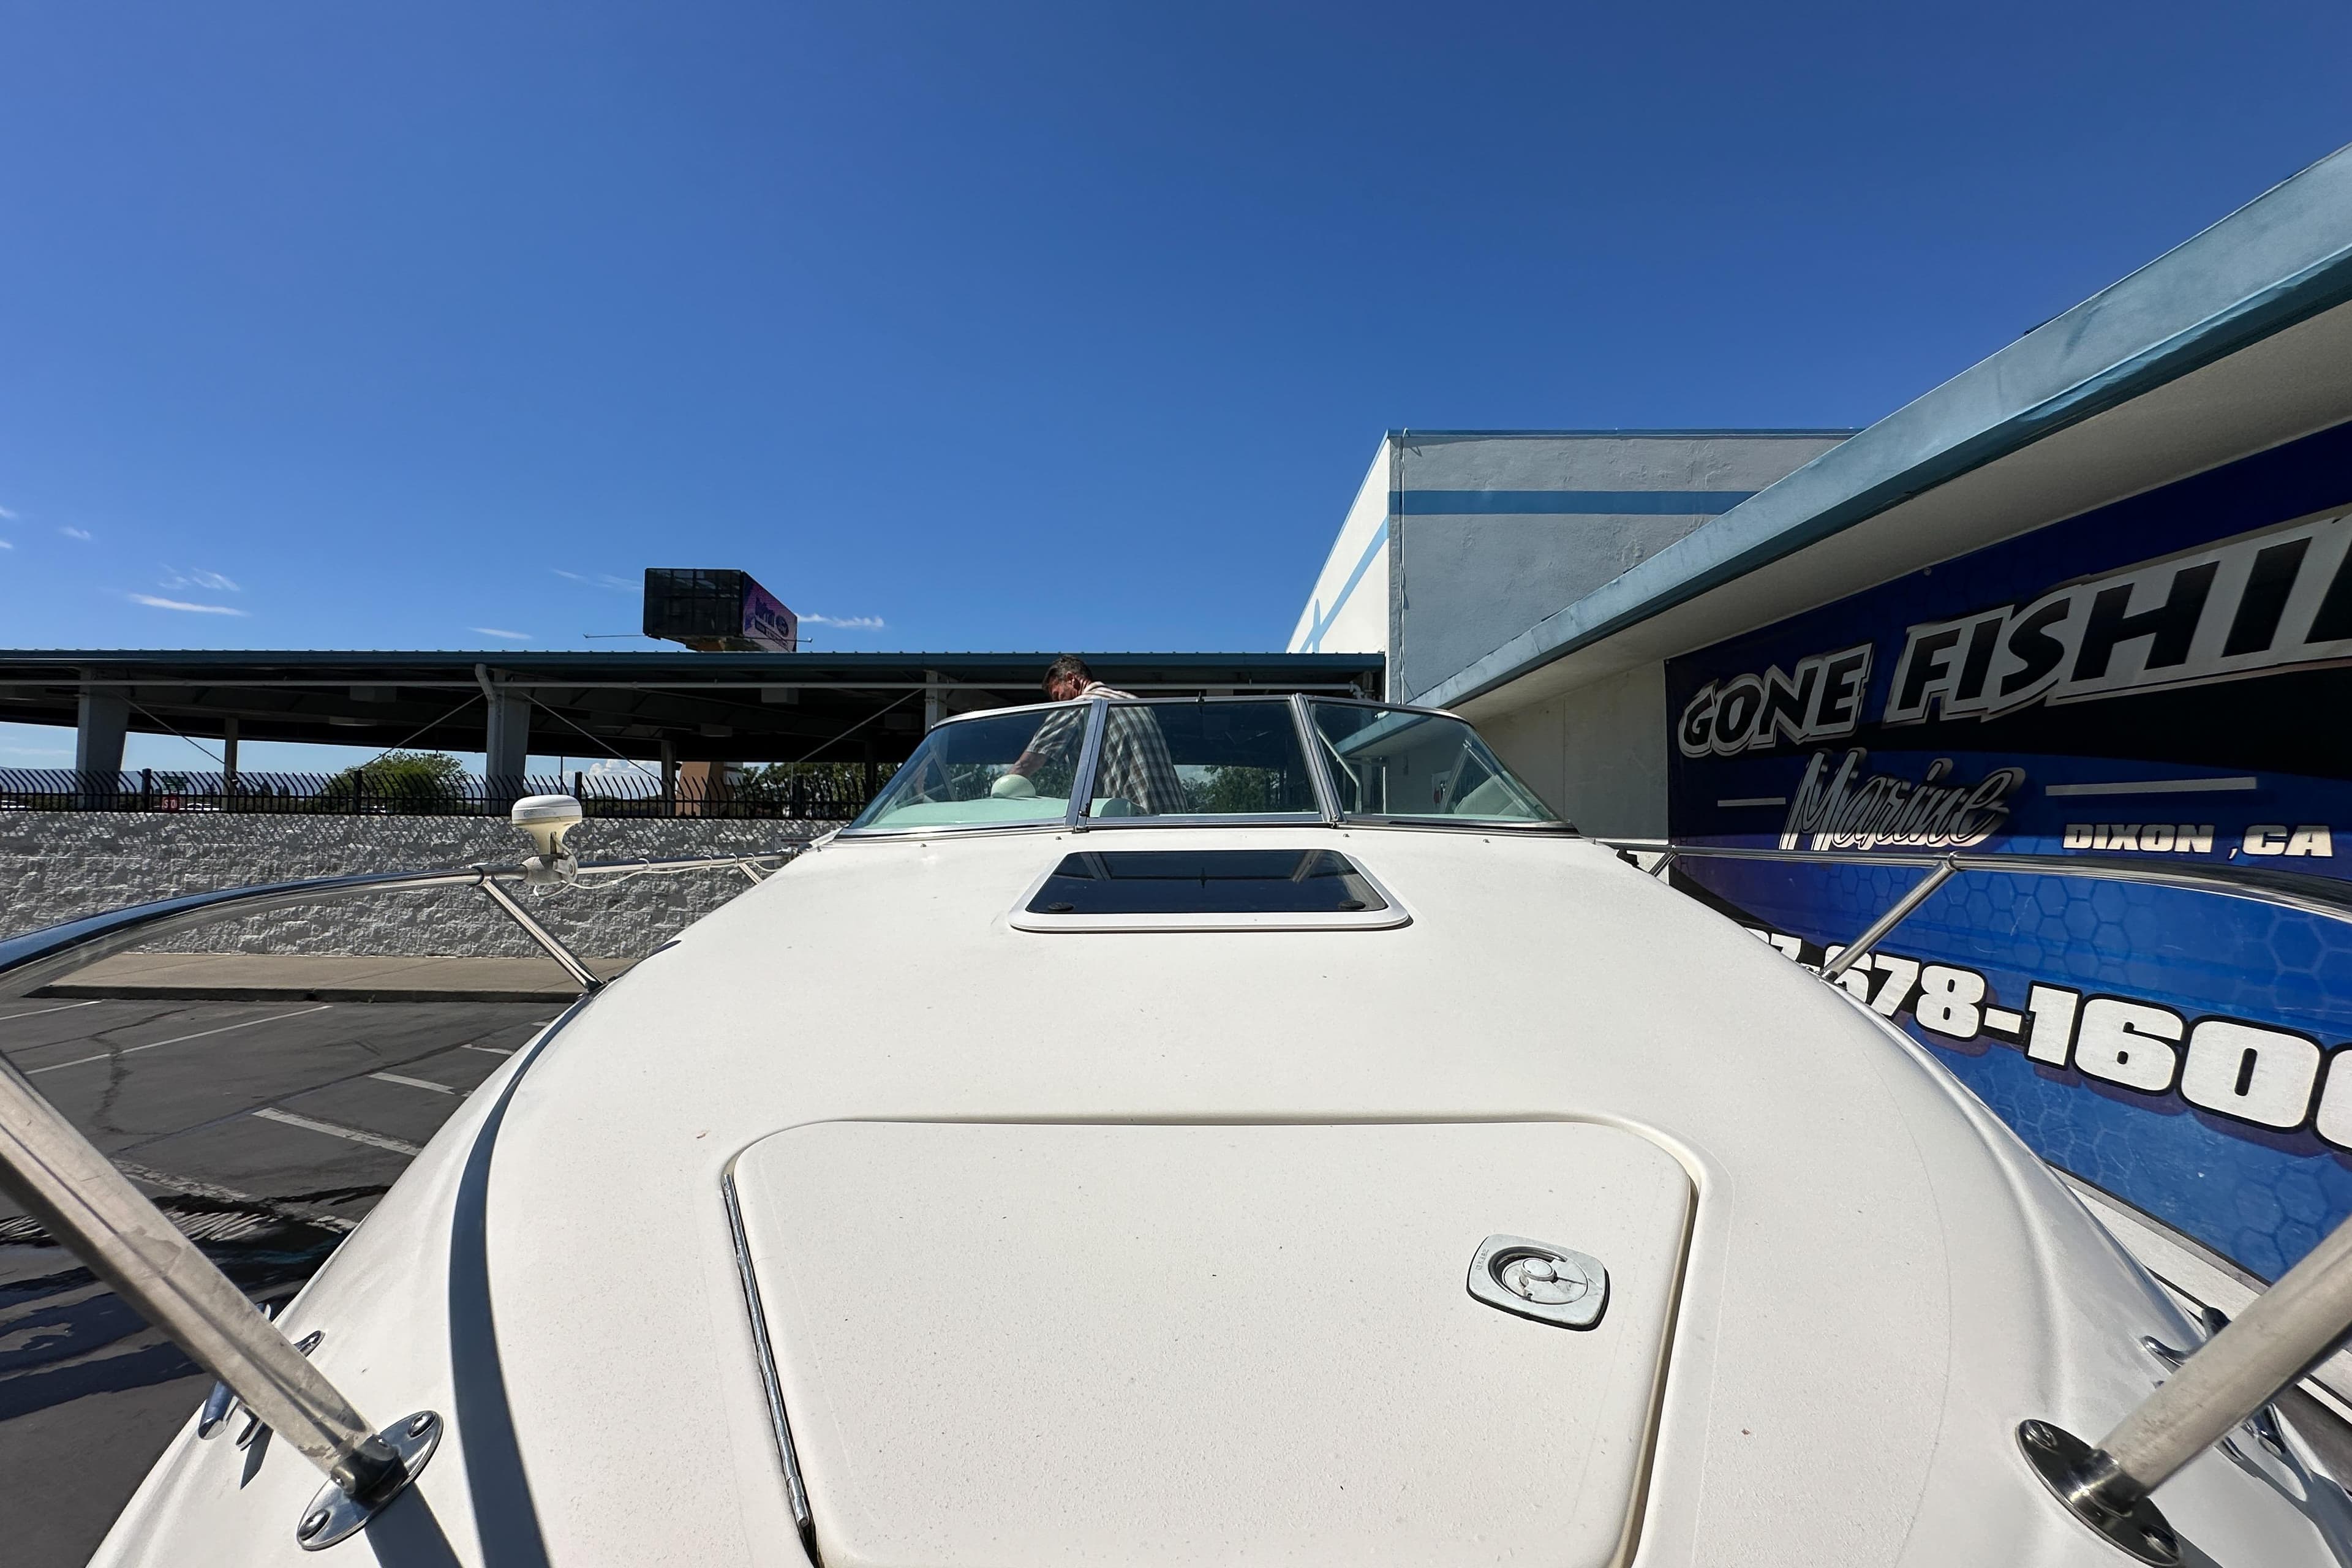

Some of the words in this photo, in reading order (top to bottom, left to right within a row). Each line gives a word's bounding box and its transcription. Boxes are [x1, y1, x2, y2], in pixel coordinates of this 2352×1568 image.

[1679, 644, 1872, 757] GONE
[1779, 748, 2025, 851] Marine
[2063, 824, 2215, 853] DIXON
